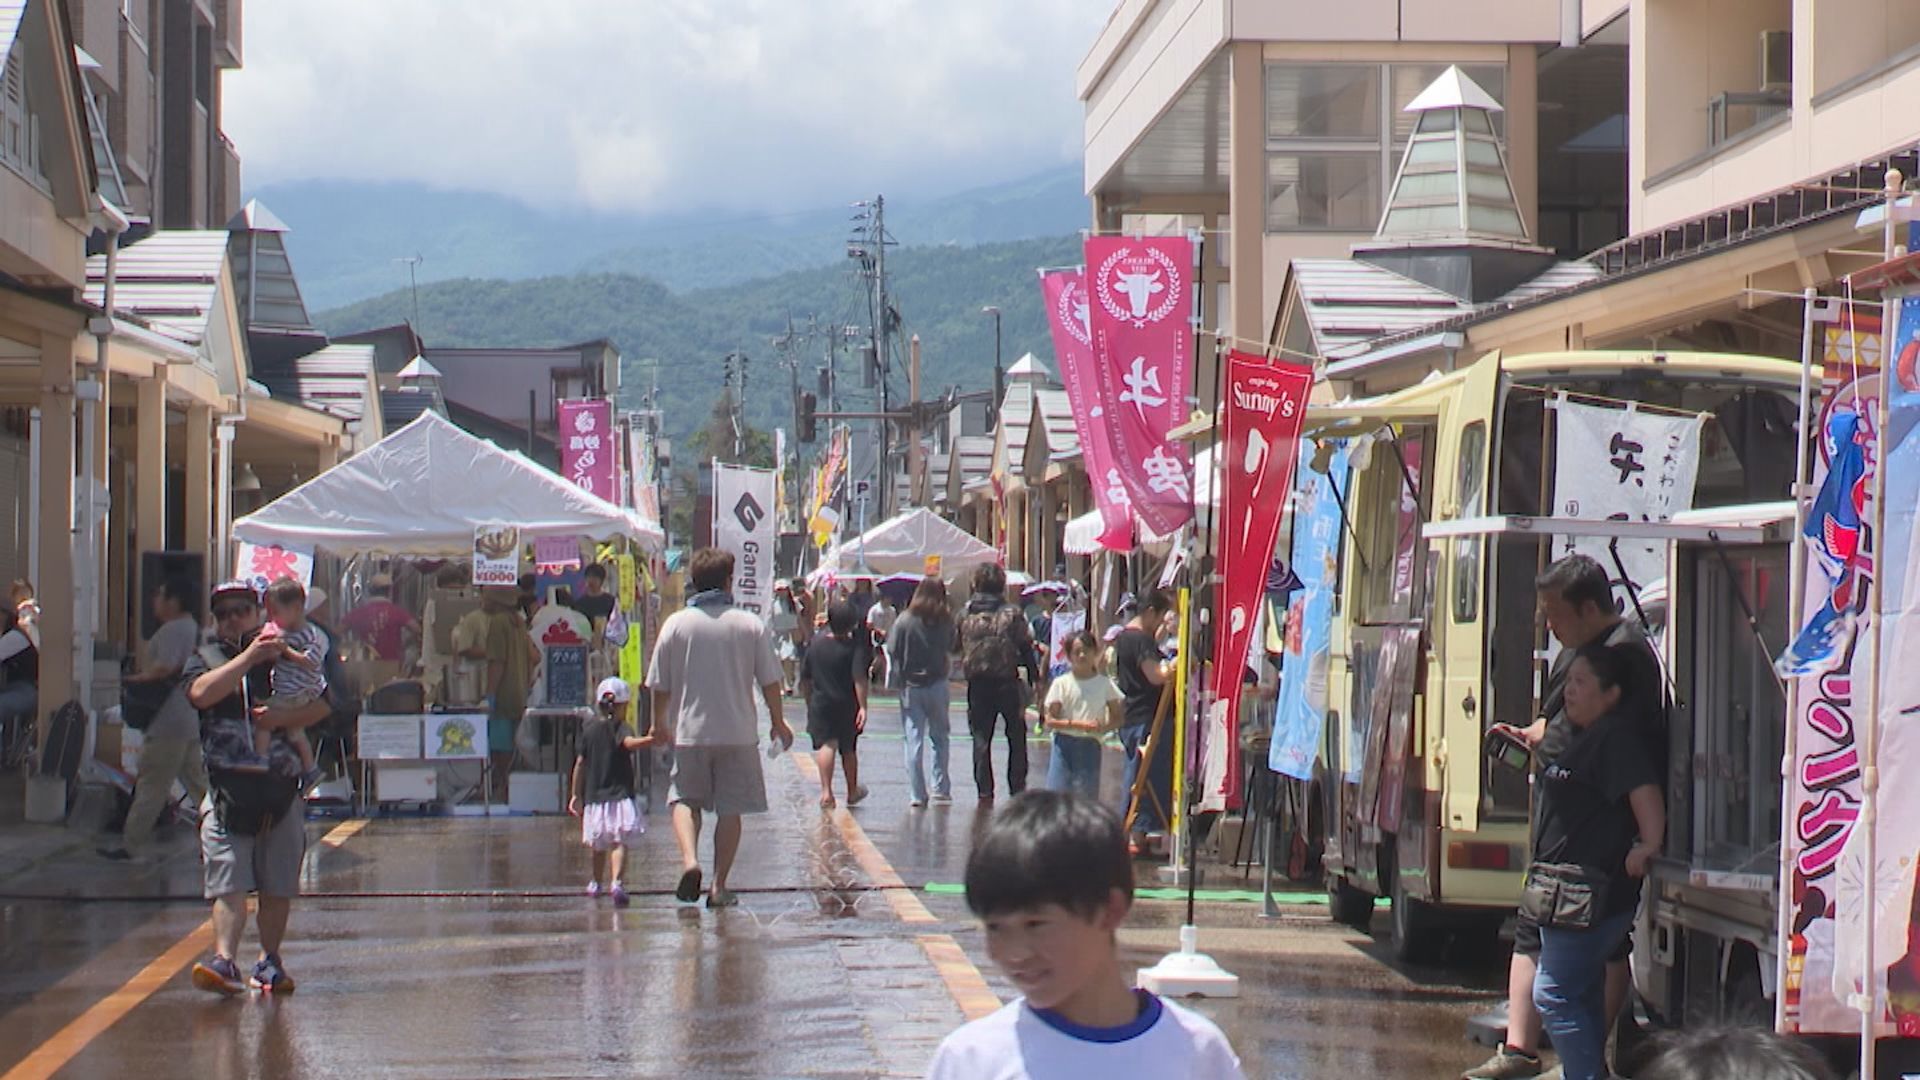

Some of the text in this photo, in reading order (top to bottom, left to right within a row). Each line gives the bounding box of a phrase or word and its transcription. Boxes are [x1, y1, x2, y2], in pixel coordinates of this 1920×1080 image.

[1233, 381, 1295, 422] Sunny's
[857, 482, 869, 495] P
[476, 572, 515, 582] ¥1000
[738, 541, 762, 595] Gangi
